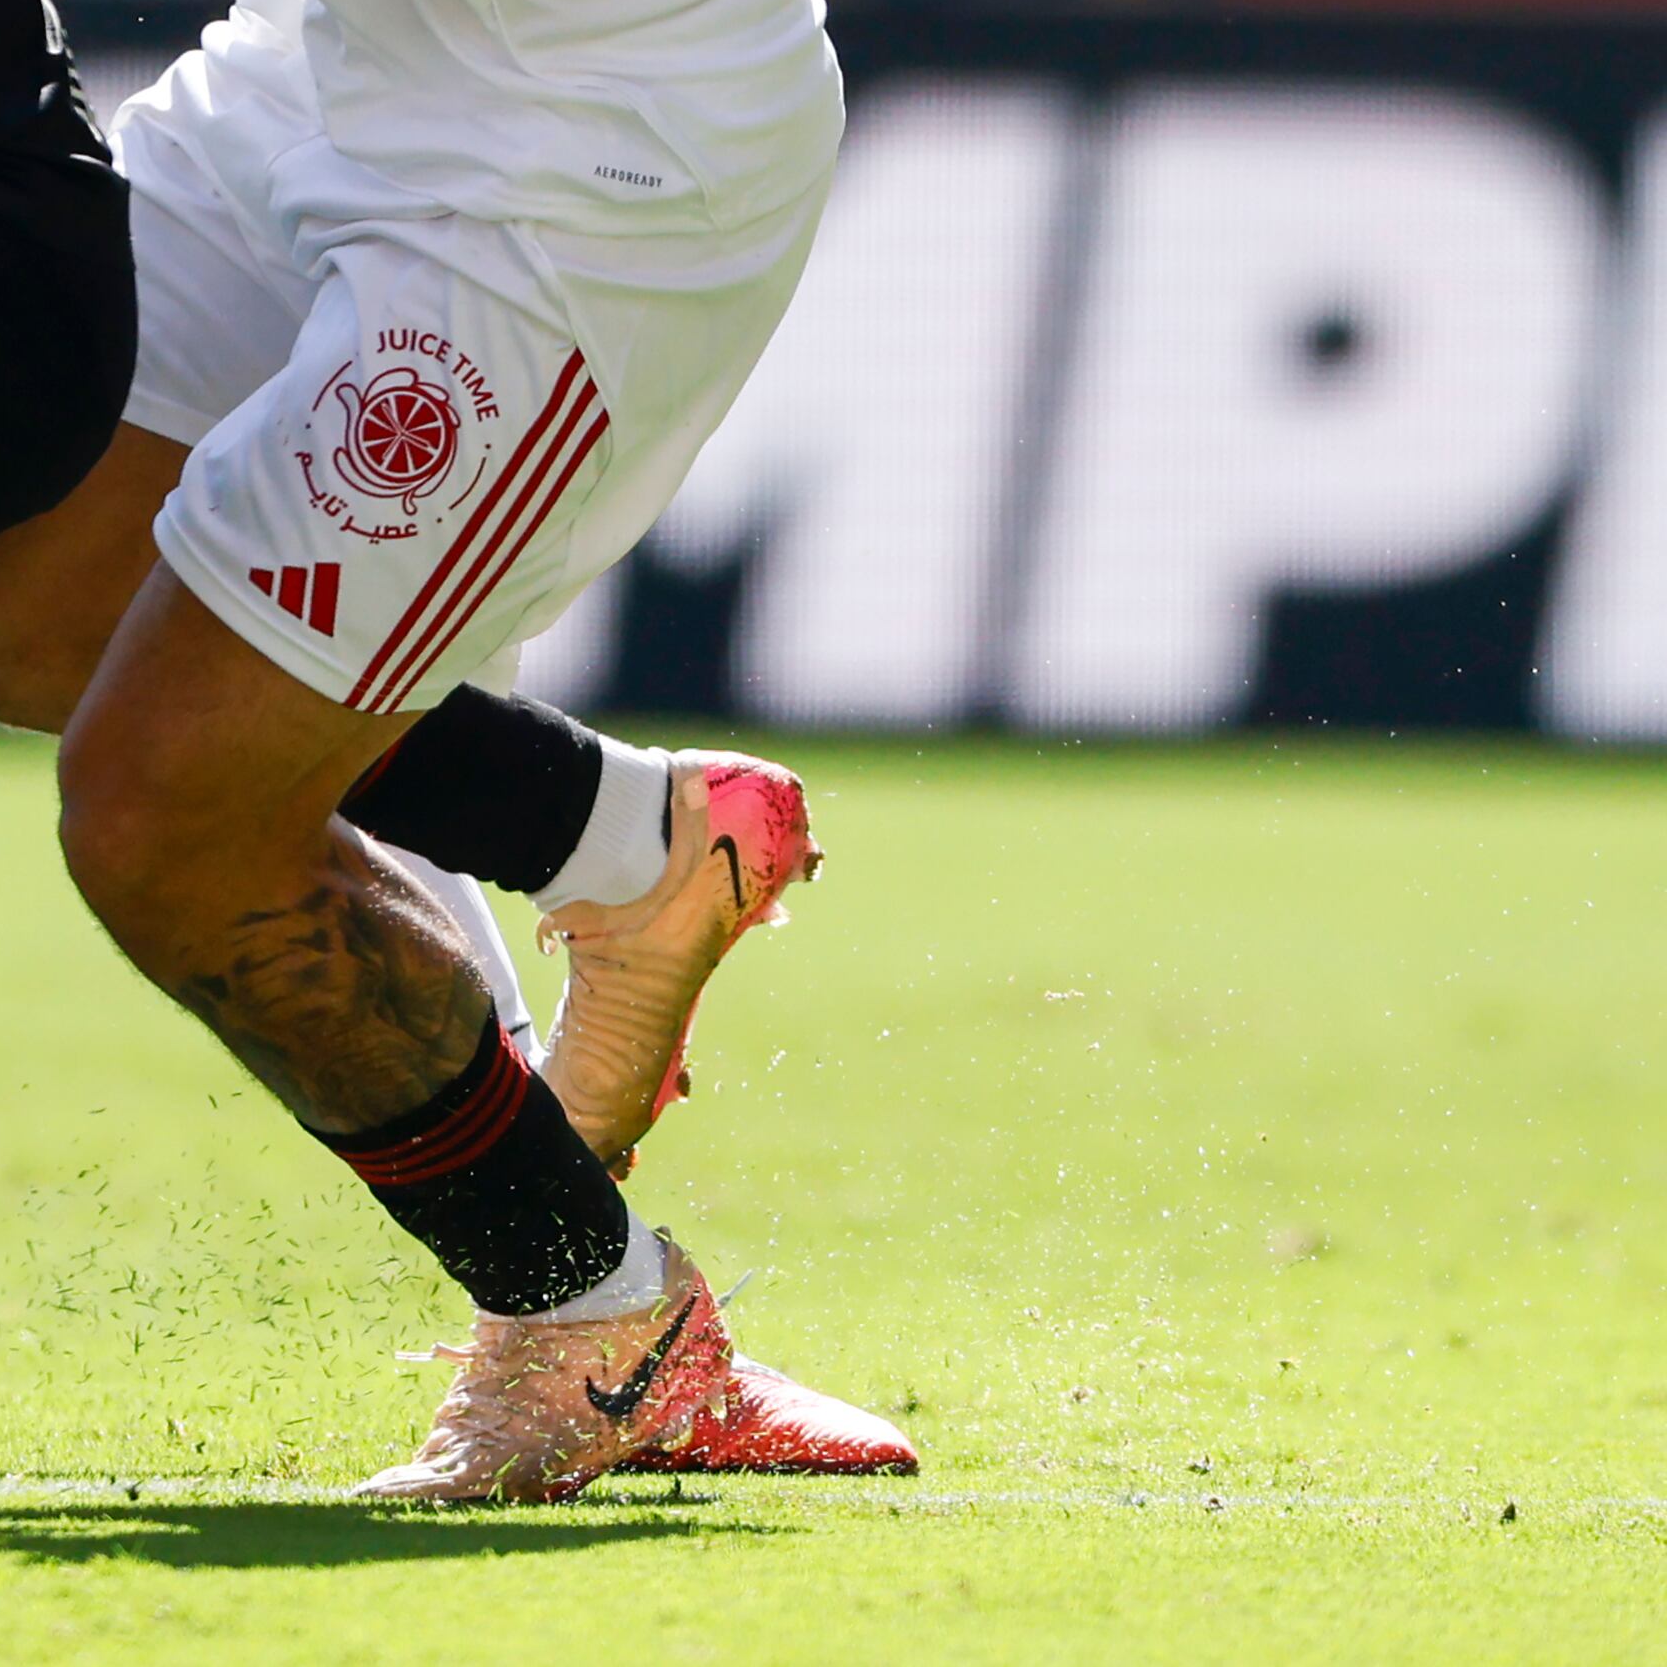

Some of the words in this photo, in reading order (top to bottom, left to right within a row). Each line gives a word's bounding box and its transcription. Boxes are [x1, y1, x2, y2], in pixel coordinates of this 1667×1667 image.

[594, 165, 663, 188] AEROREADY
[376, 328, 452, 364] JUICE
[451, 352, 500, 423] TIME
